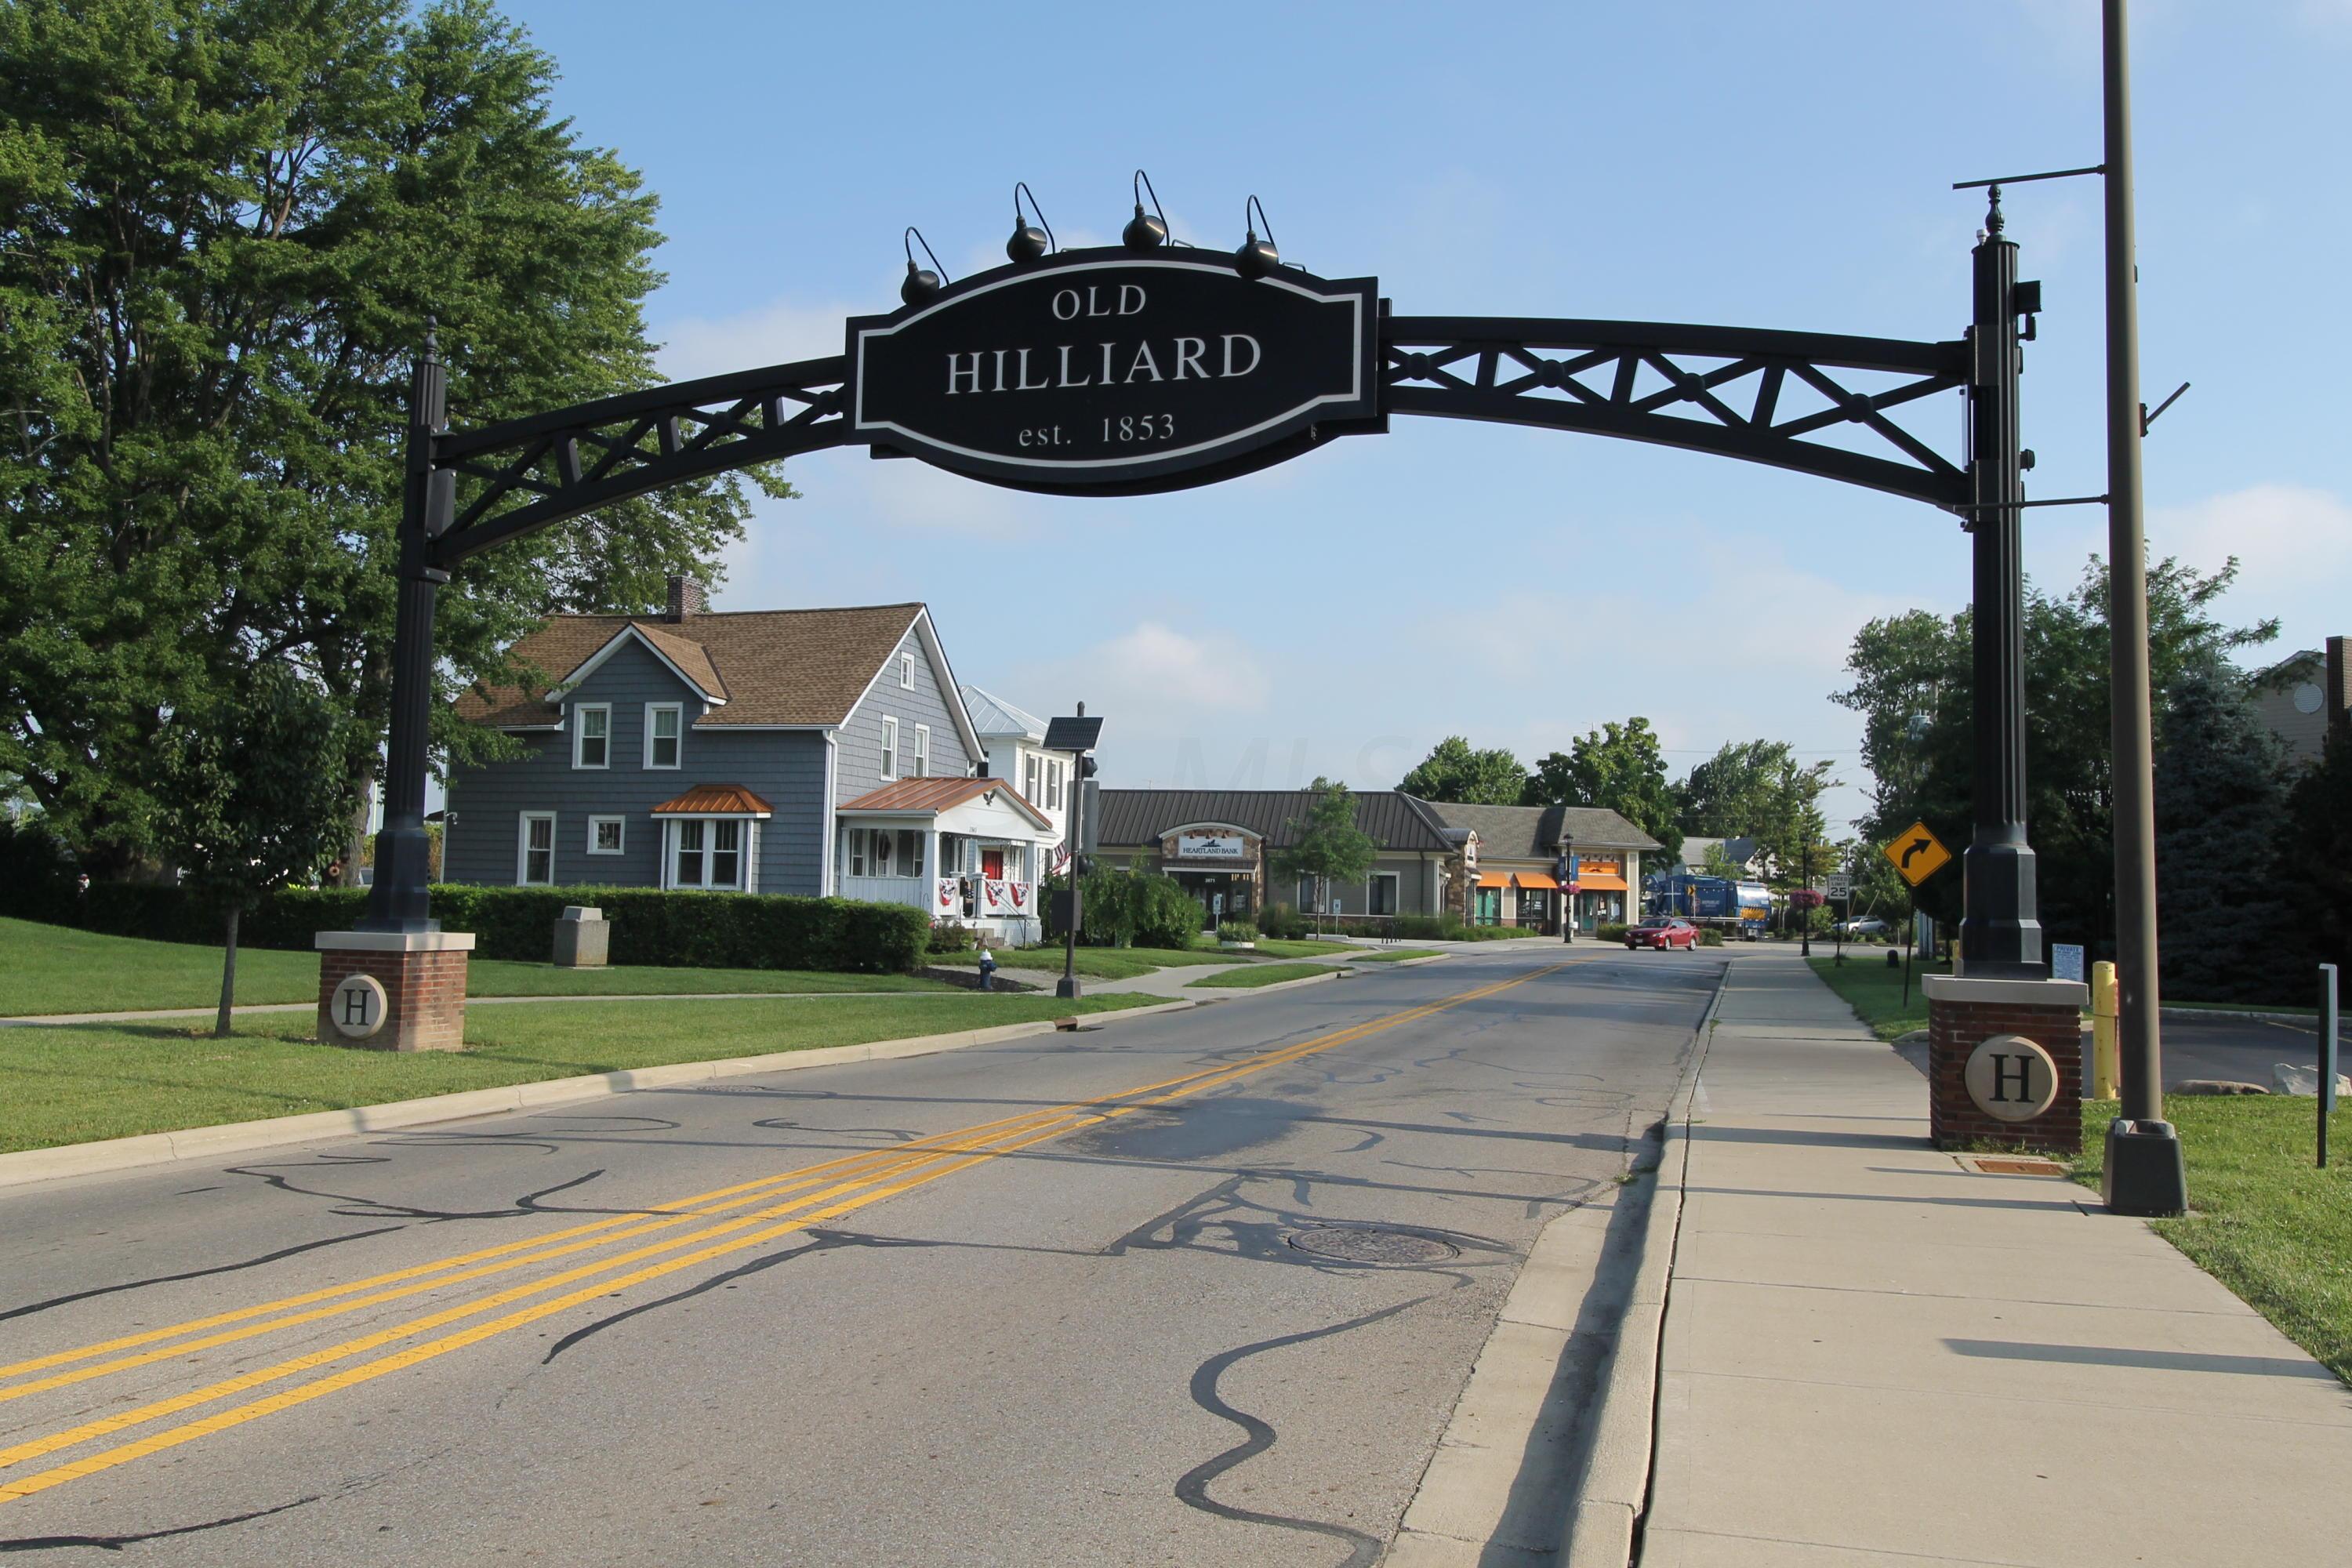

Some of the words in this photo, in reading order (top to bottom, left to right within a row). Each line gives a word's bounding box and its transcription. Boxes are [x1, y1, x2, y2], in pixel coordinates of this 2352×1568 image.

[1053, 285, 1145, 320] OLD
[946, 335, 1260, 394] HILLIARD
[1019, 426, 1070, 446] est.
[1104, 414, 1173, 441] 1853
[1831, 887, 1847, 897] 25
[341, 988, 372, 1025] H
[1988, 1054, 2035, 1103] H
